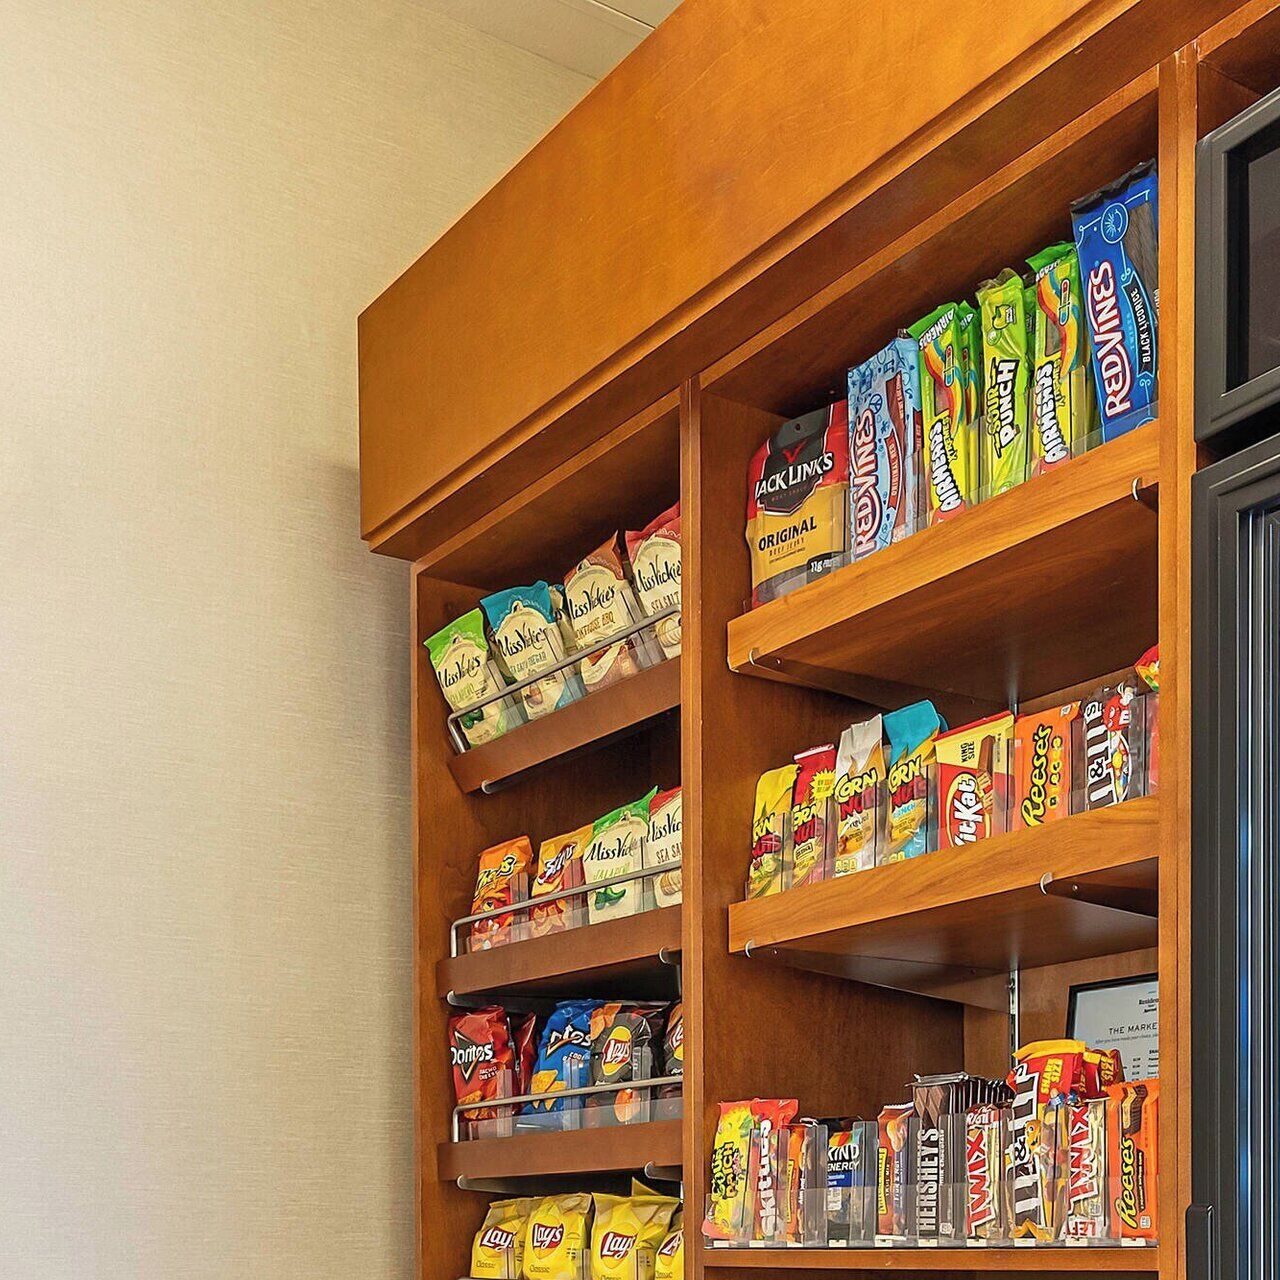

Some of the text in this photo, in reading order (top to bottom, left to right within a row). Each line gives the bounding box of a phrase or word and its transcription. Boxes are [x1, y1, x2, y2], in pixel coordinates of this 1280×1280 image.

[1131, 288, 1151, 362] BLACK LICORICE
[987, 385, 1000, 434] SOUR
[997, 361, 1017, 447] PUNCH
[1037, 362, 1068, 463] AIRHEADS
[755, 452, 833, 499] JACK LINK'S
[929, 421, 962, 512] AIRHEADS
[758, 516, 817, 551] ORIGINAL
[960, 743, 968, 763] KING
[835, 768, 877, 803] CORN
[889, 756, 921, 793] CORN
[1021, 724, 1052, 827] Reese's
[1109, 1021, 1157, 1036] THE MARKE
[450, 1043, 494, 1066] Doritos
[827, 1161, 860, 1172] ENERGY
[828, 1144, 860, 1161] KIND
[918, 1128, 939, 1231] HERSHEY'S
[1115, 1137, 1136, 1229] Reese's
[533, 1223, 564, 1249] Lay's
